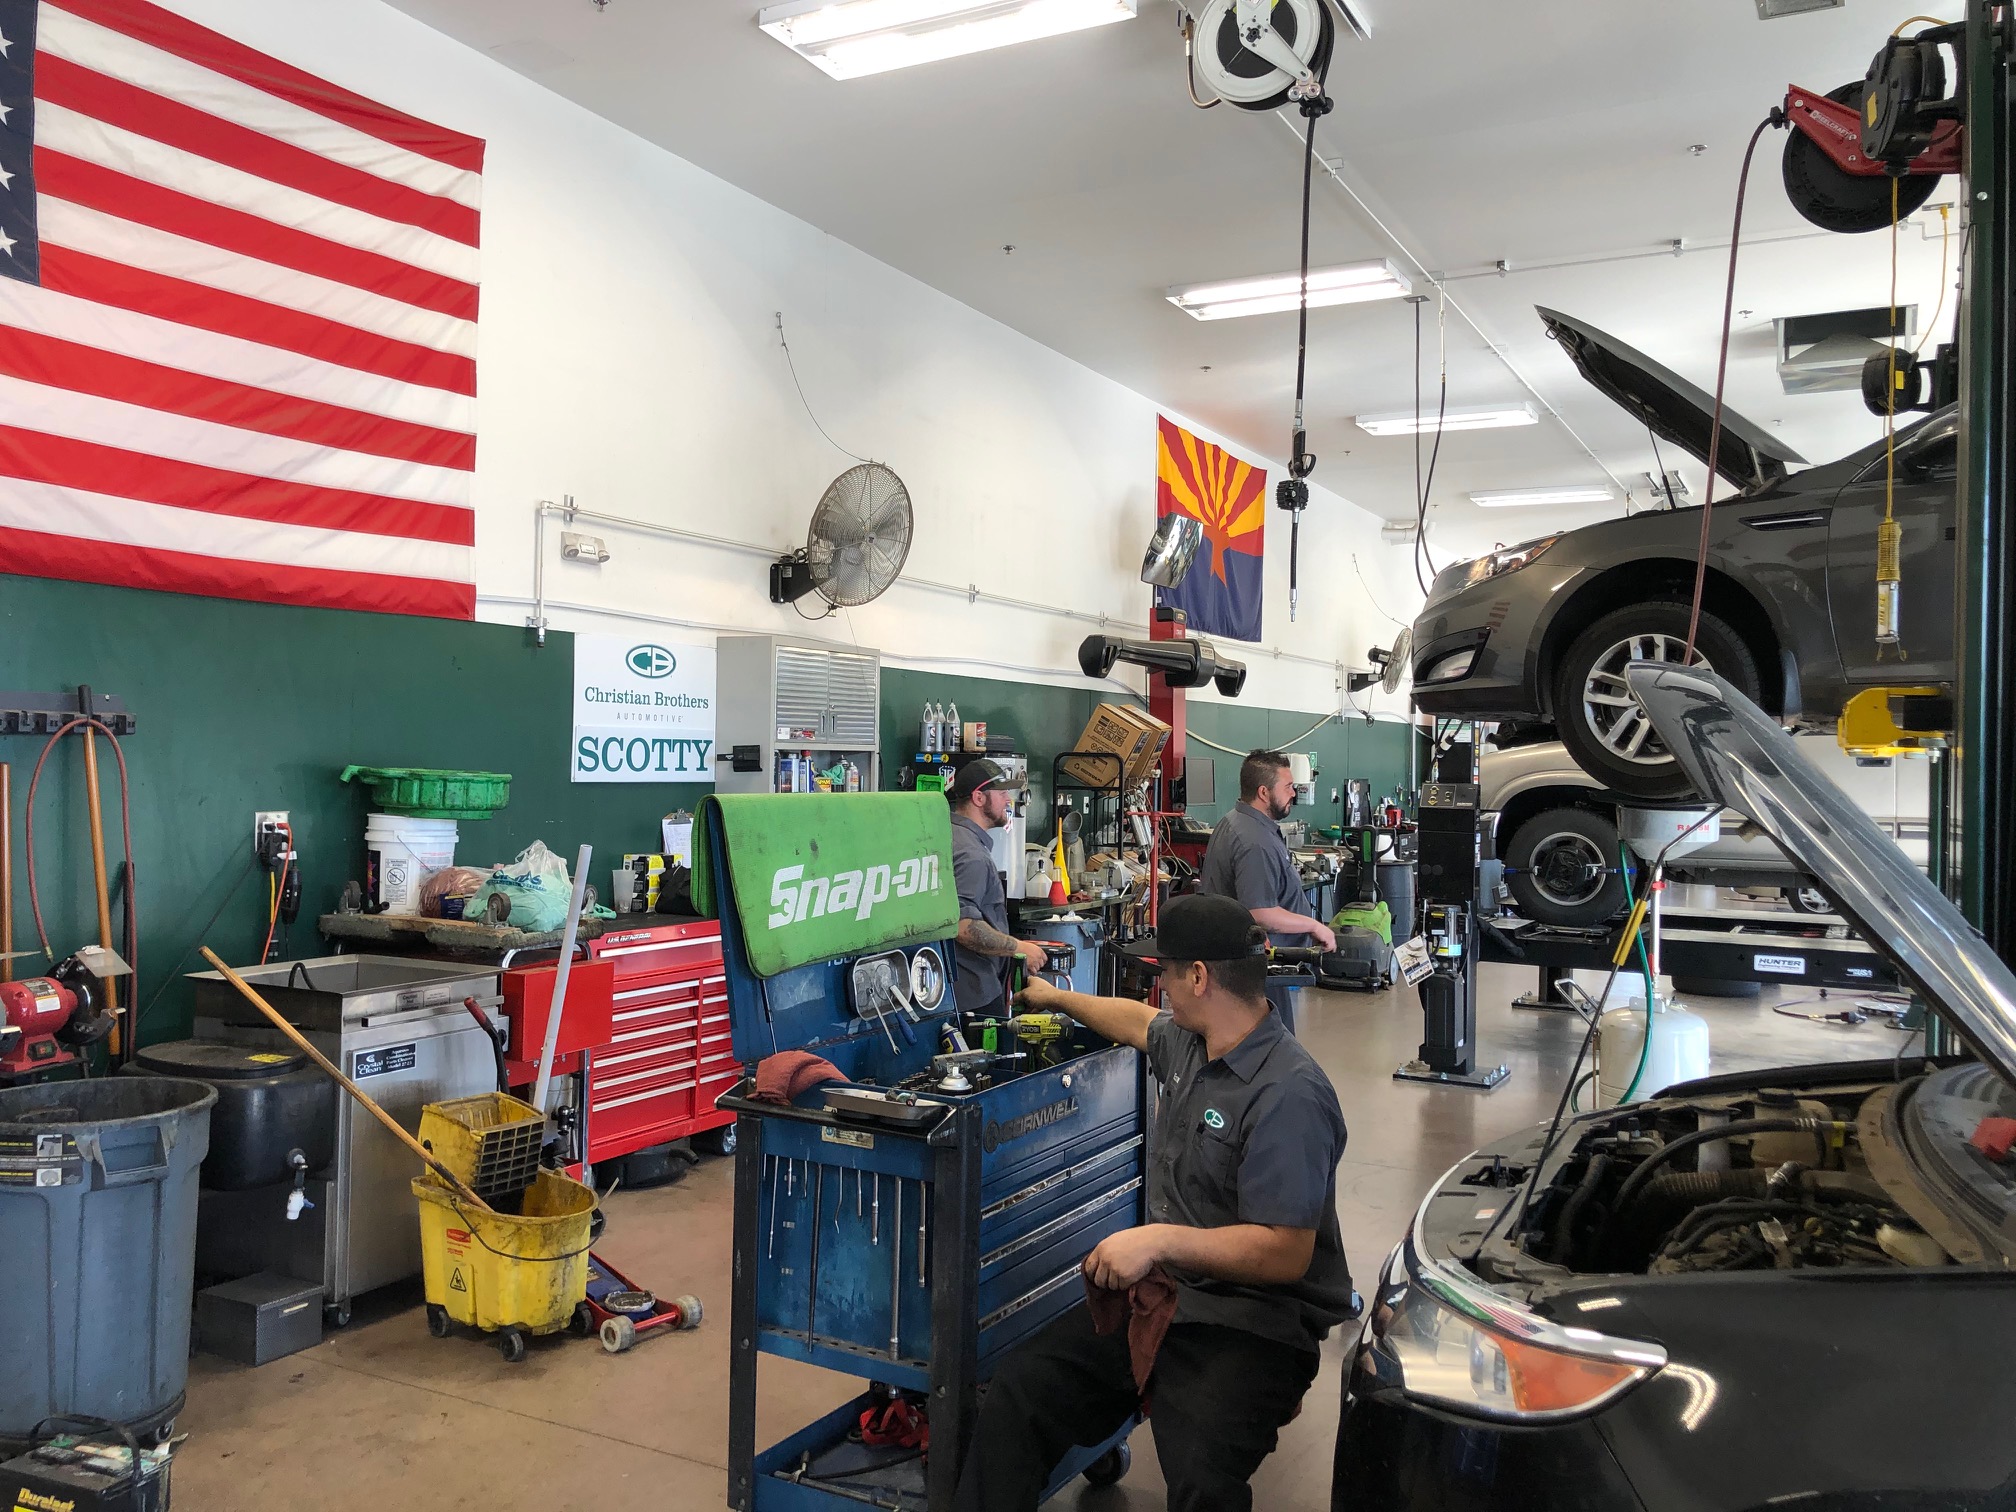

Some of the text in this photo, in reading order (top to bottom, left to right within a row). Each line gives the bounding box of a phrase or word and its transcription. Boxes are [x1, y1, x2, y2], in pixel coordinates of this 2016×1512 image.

[584, 686, 709, 709] Christian Brothers
[616, 712, 683, 723] AUTOMOTIVE
[577, 736, 713, 772] SCOTTY
[768, 854, 939, 930] Snap-on
[1759, 958, 1802, 966] HUNTER
[357, 1060, 384, 1071] Crystal
[359, 1066, 382, 1075] Clean
[1001, 1096, 1079, 1143] CORNWELL
